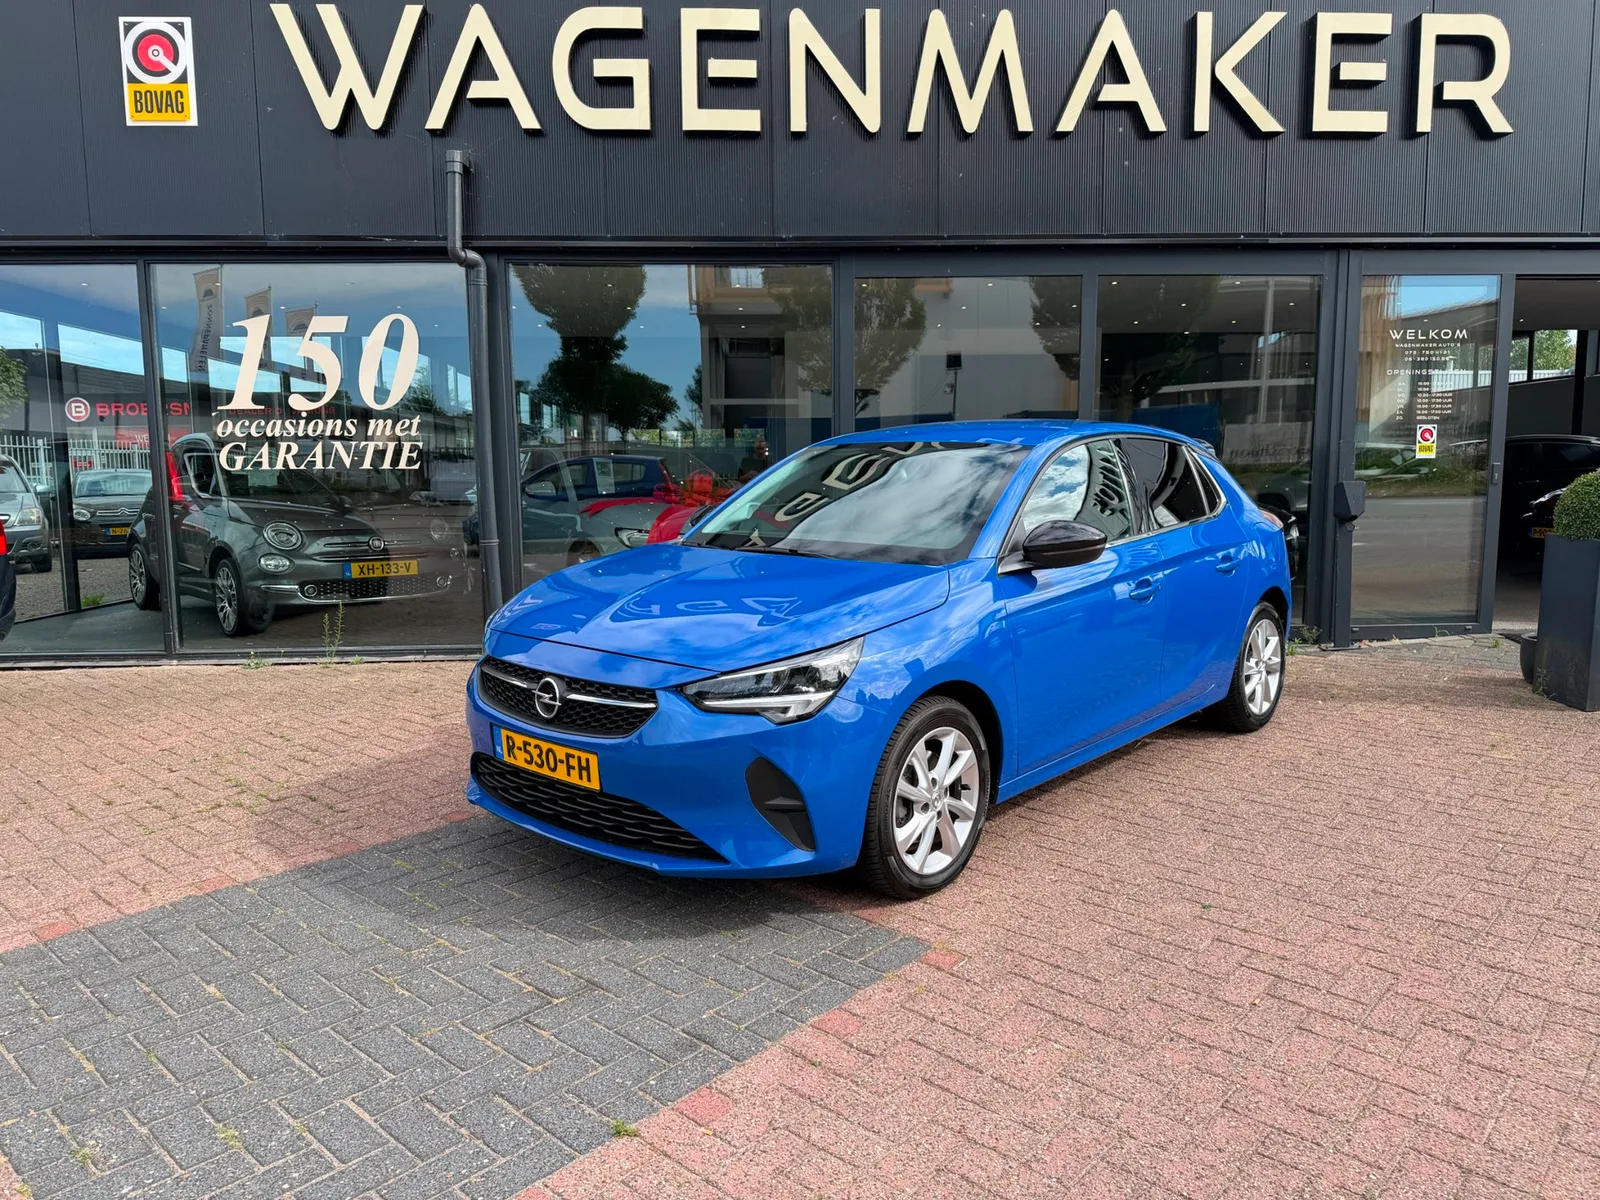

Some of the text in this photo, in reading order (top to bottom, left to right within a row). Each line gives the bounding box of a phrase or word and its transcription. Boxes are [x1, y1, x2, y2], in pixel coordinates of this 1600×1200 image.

[269, 3, 1514, 134] WAGENMAKER
[133, 90, 186, 115] BOVAG
[1389, 329, 1468, 340] WELKOM
[217, 313, 420, 411] 150
[216, 411, 422, 438] occasions met
[218, 441, 424, 470] GARANTIE
[358, 562, 411, 576] XH-133-V
[506, 734, 591, 782] R-530-FH
